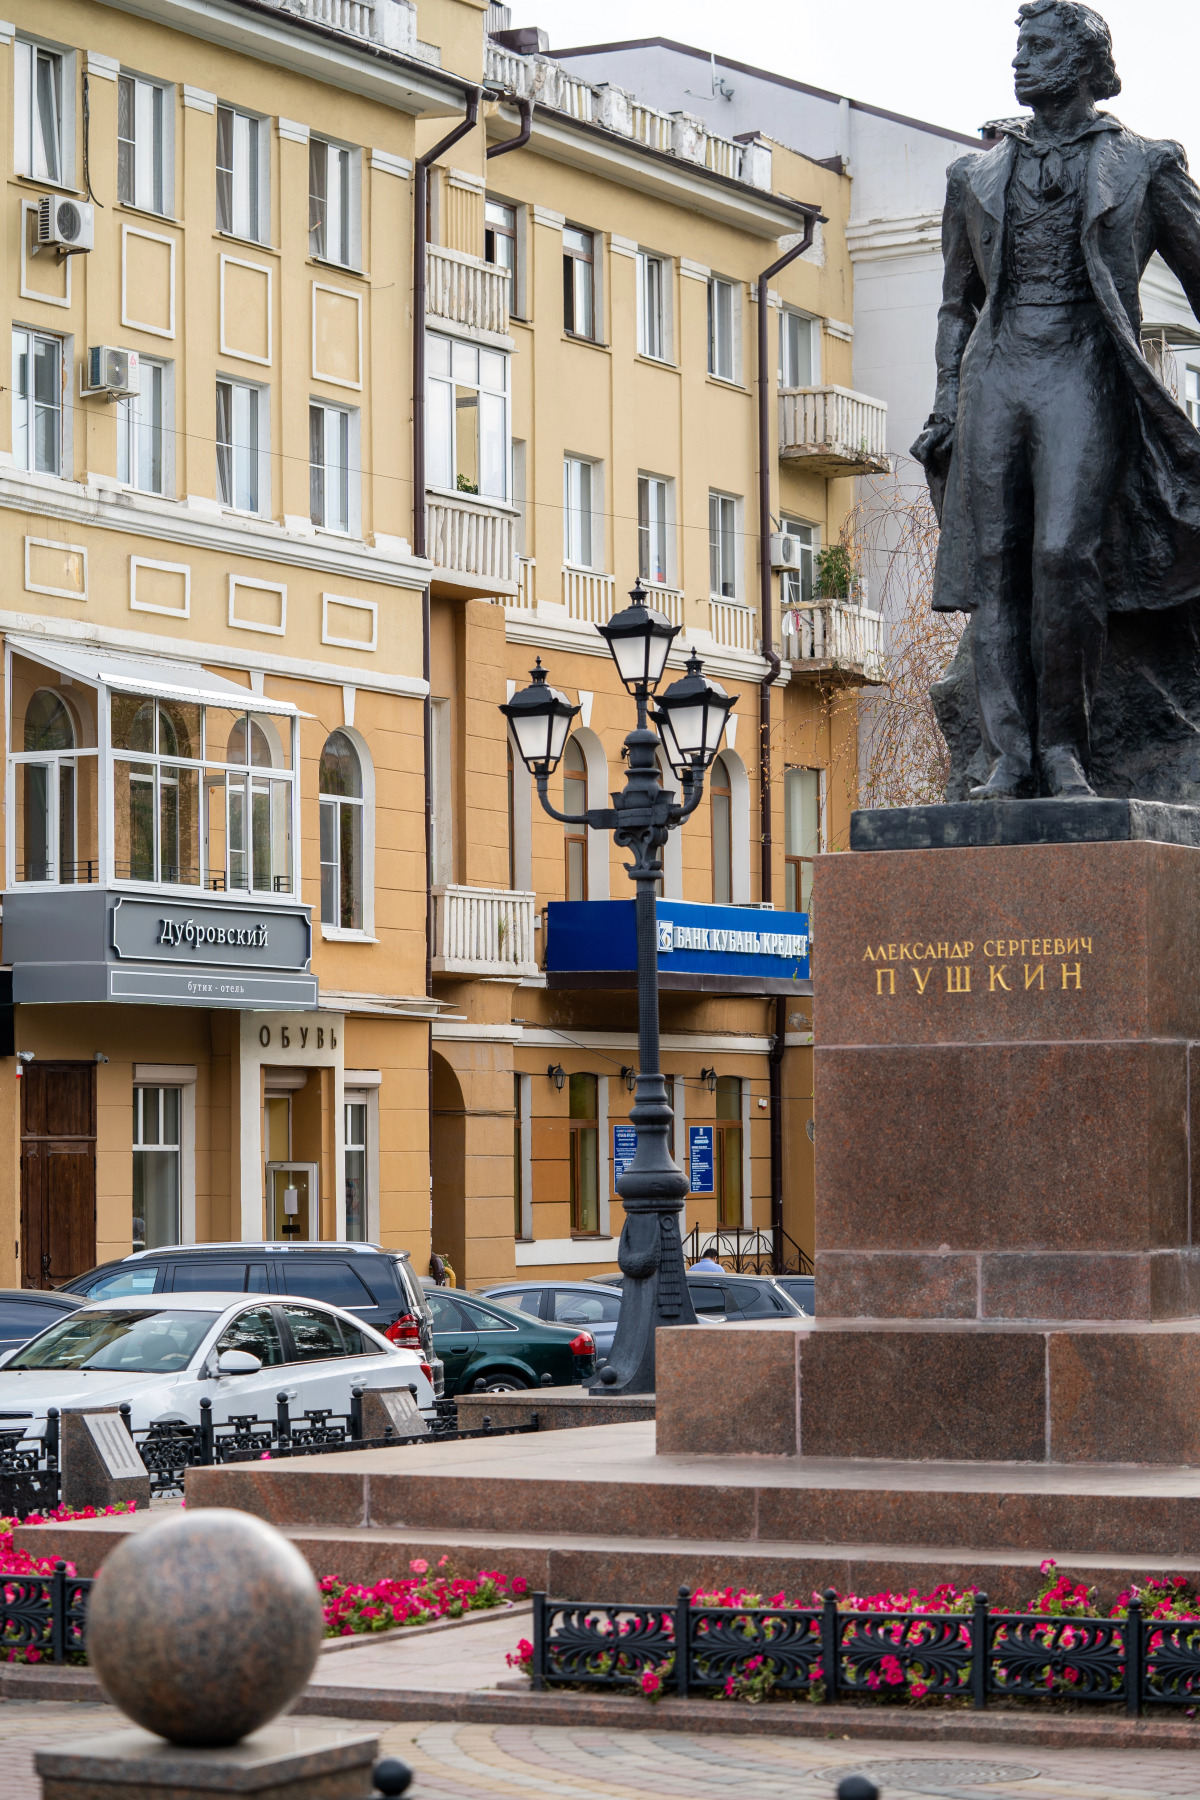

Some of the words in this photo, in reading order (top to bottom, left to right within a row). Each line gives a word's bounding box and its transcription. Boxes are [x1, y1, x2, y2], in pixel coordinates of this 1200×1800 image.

[160, 919, 269, 948] Дубровский
[676, 926, 711, 950] БАНК
[712, 929, 761, 954] КУБАНЬ
[762, 932, 808, 958] КРЕДИТ
[862, 941, 975, 962] АЛЕКСАНДР
[983, 937, 1093, 958] СЕРГЕЕВИЧ
[187, 980, 213, 993] бутик
[220, 982, 245, 993] отель
[876, 962, 1082, 995] ПУШКИН
[259, 1025, 337, 1050] ОБУВЬ
